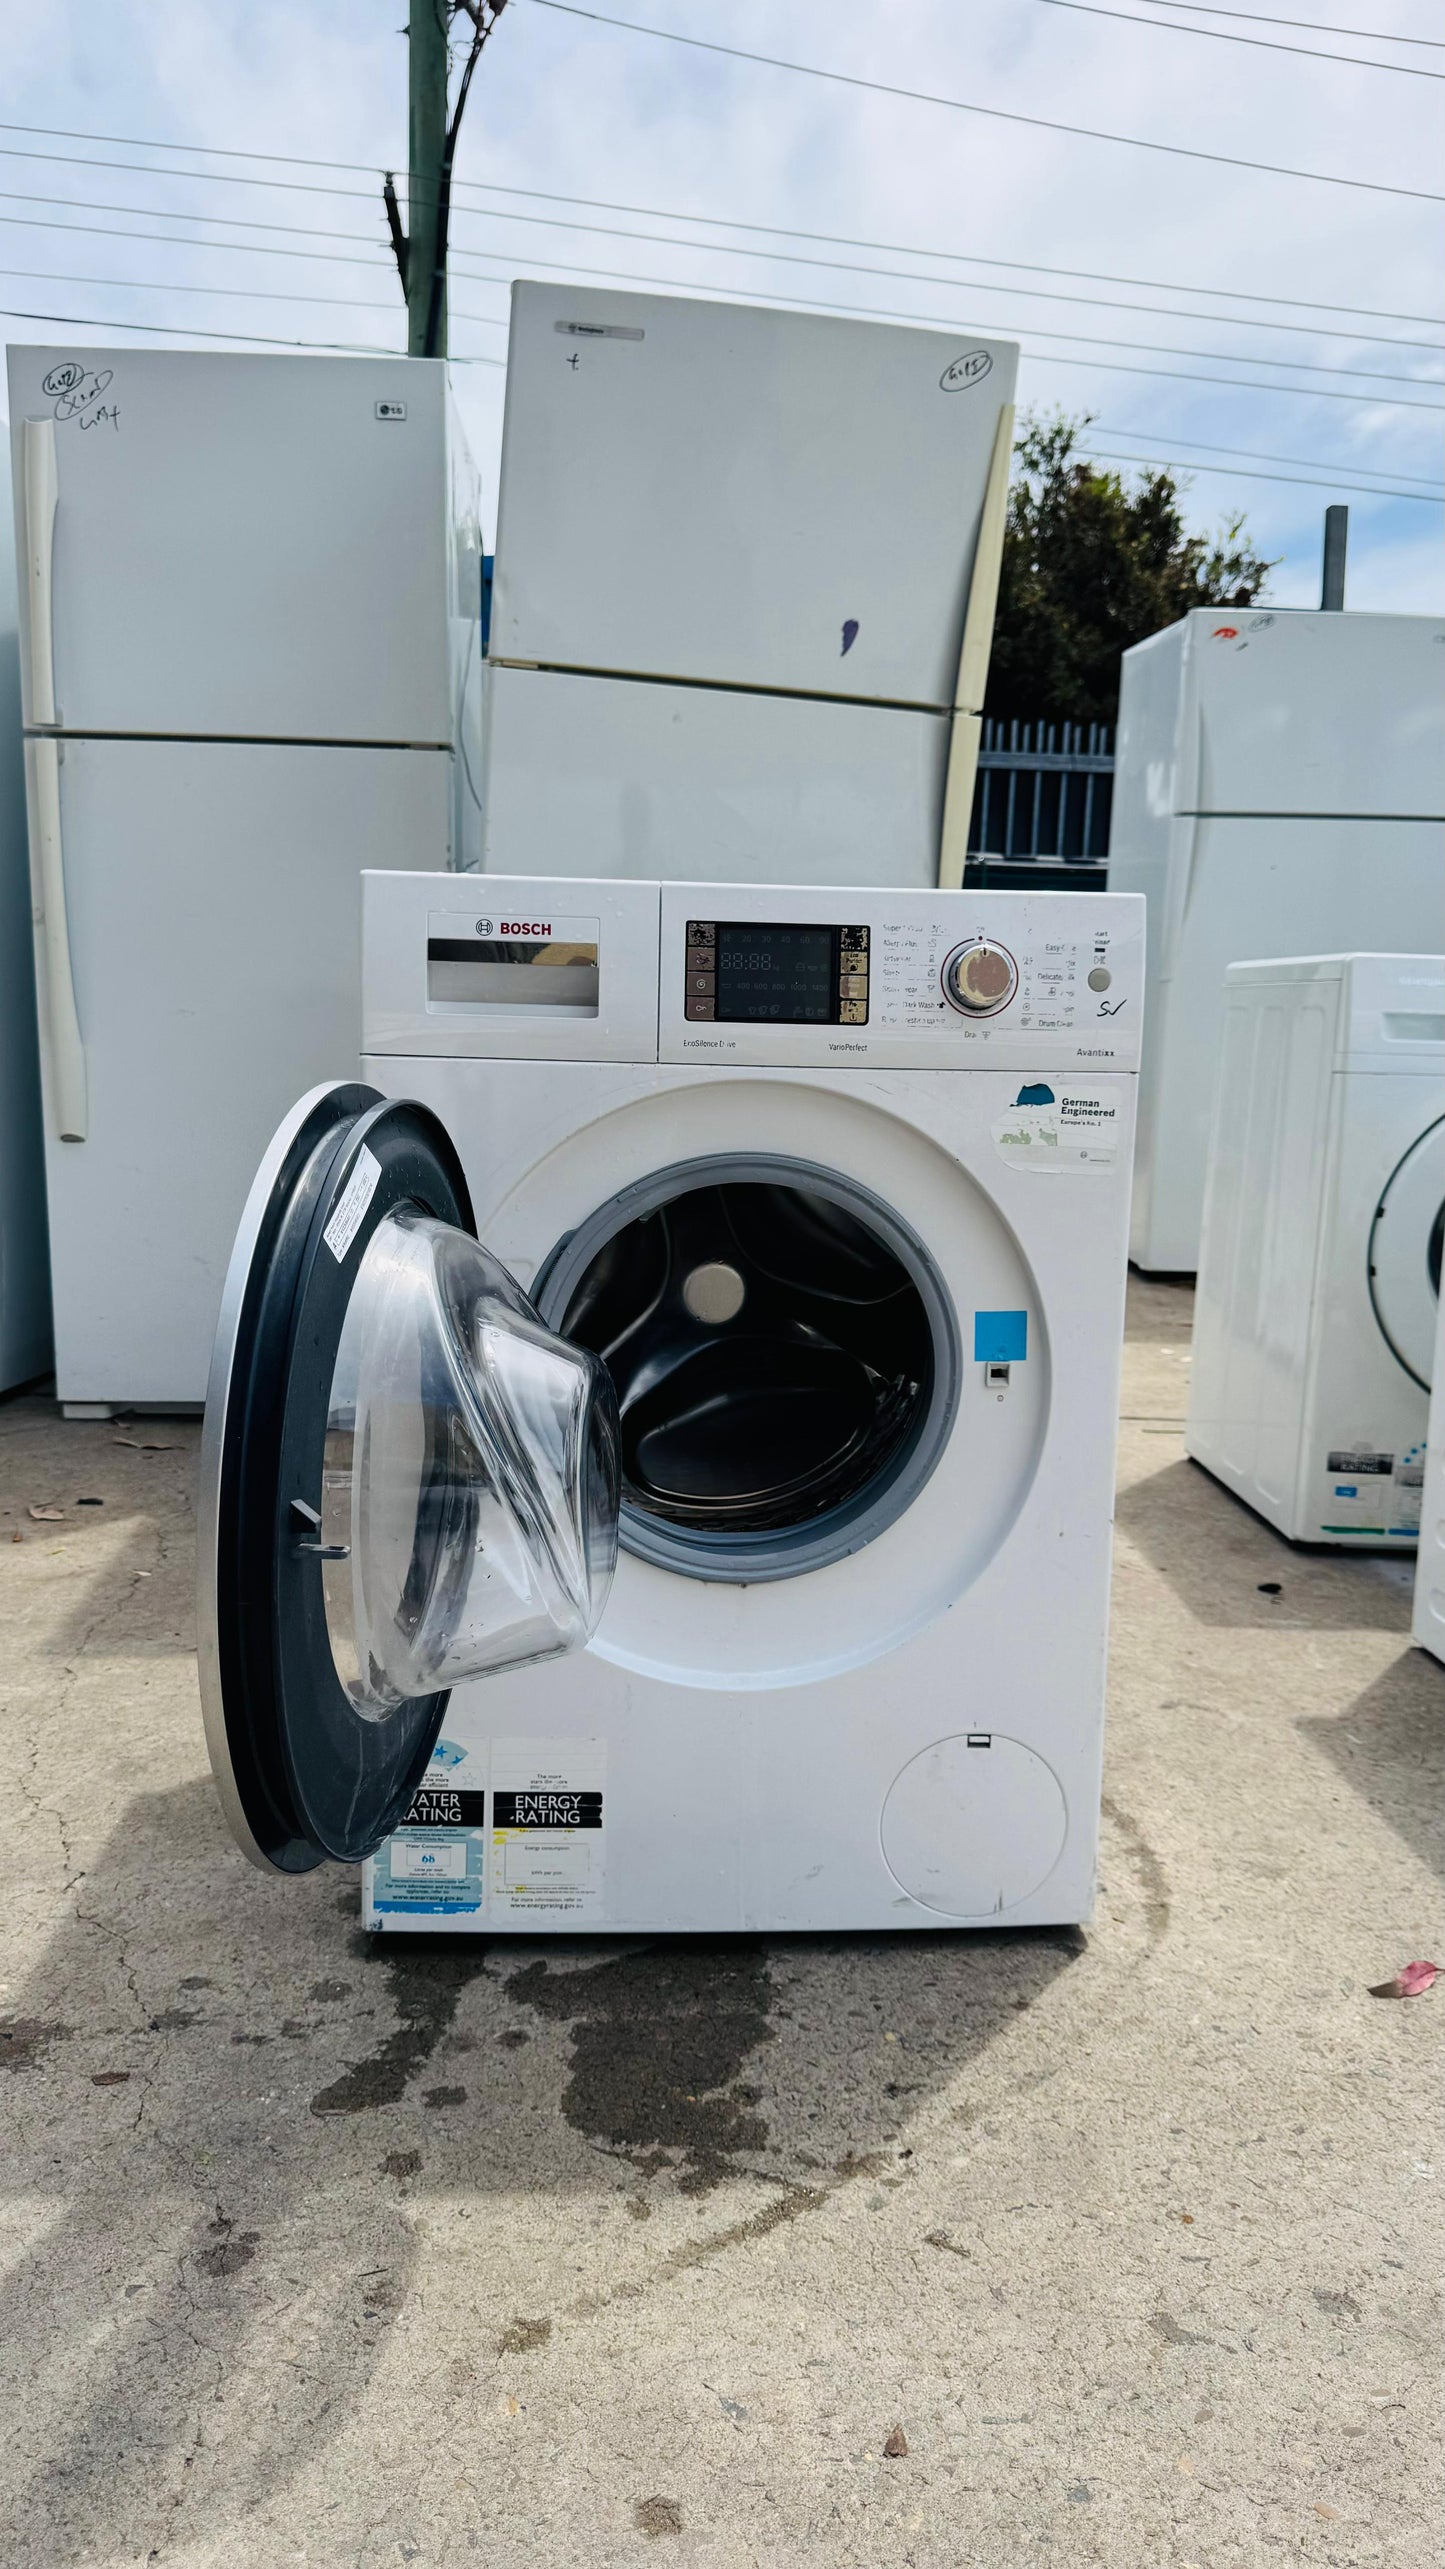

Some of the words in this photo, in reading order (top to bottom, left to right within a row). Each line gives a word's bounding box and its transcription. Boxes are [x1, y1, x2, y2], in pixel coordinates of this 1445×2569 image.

[500, 922, 552, 936] BOSCH
[918, 1001, 935, 1009] Wash
[683, 1039, 718, 1048] EcoSilence
[719, 1040, 736, 1049] Dive
[828, 1042, 868, 1052] VarioPerfect
[1076, 1048, 1115, 1057] Avantixx
[1061, 1097, 1100, 1108] German
[1061, 1107, 1116, 1117] Engineered
[1060, 1119, 1086, 1127] Europe's
[515, 1795, 582, 1810] ENERGY
[403, 1807, 462, 1822] ATING
[515, 1810, 581, 1824] RATING
